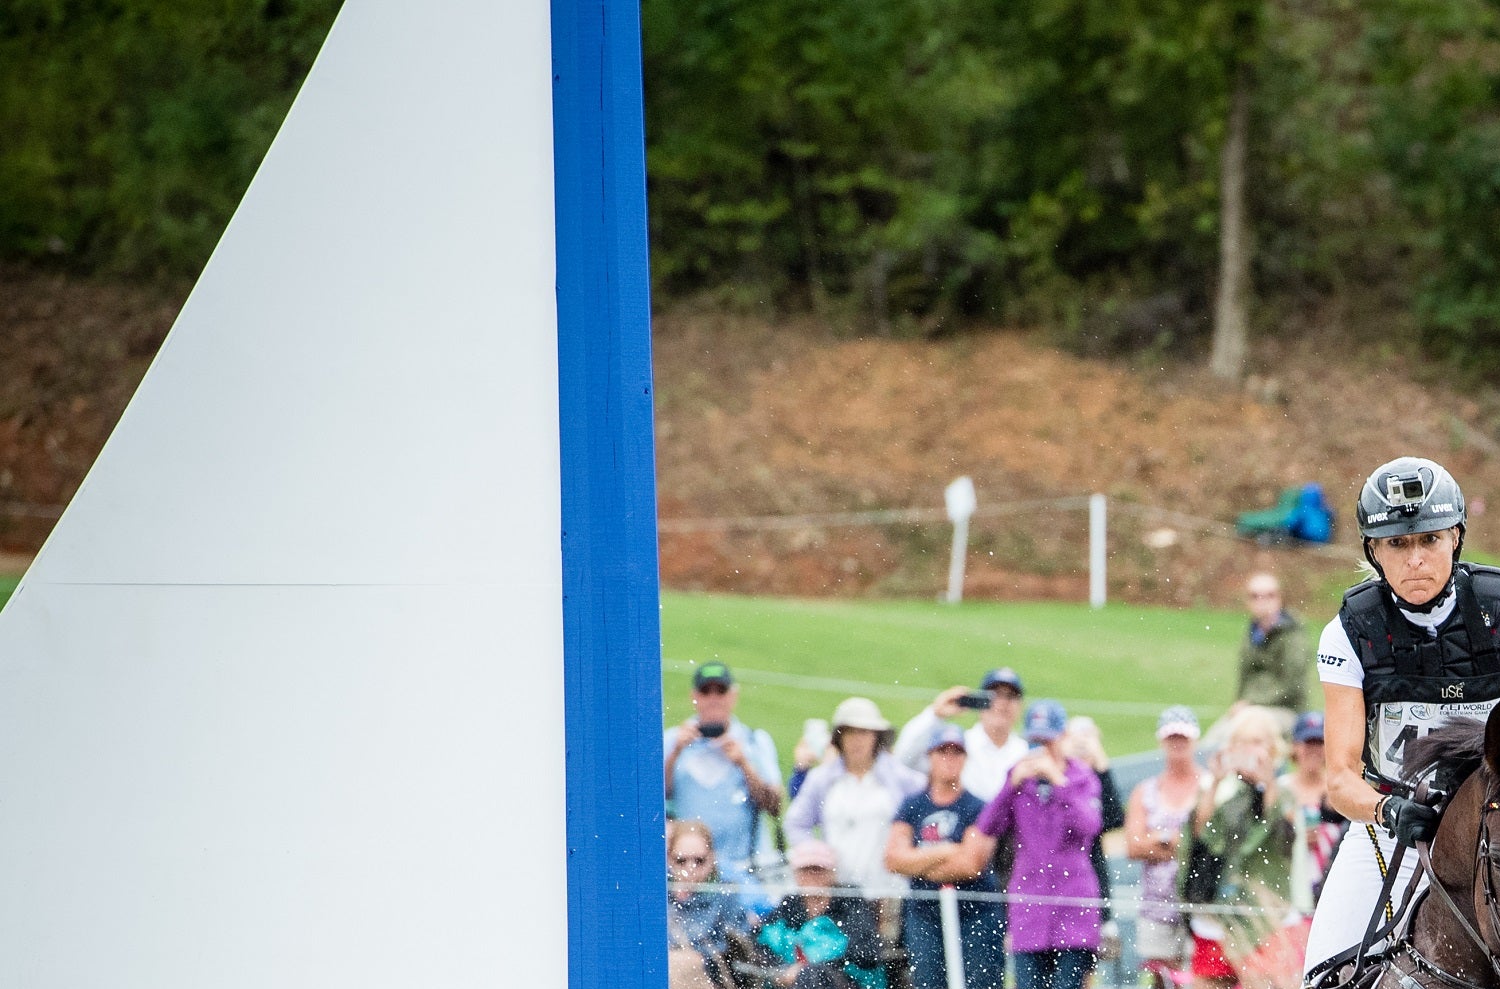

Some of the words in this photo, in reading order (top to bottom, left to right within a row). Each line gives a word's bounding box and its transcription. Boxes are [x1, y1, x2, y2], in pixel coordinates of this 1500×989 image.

[1431, 503, 1454, 514] uvex
[1367, 512, 1388, 524] uvex
[1441, 684, 1464, 699] USG
[1462, 703, 1493, 711] WORLD
